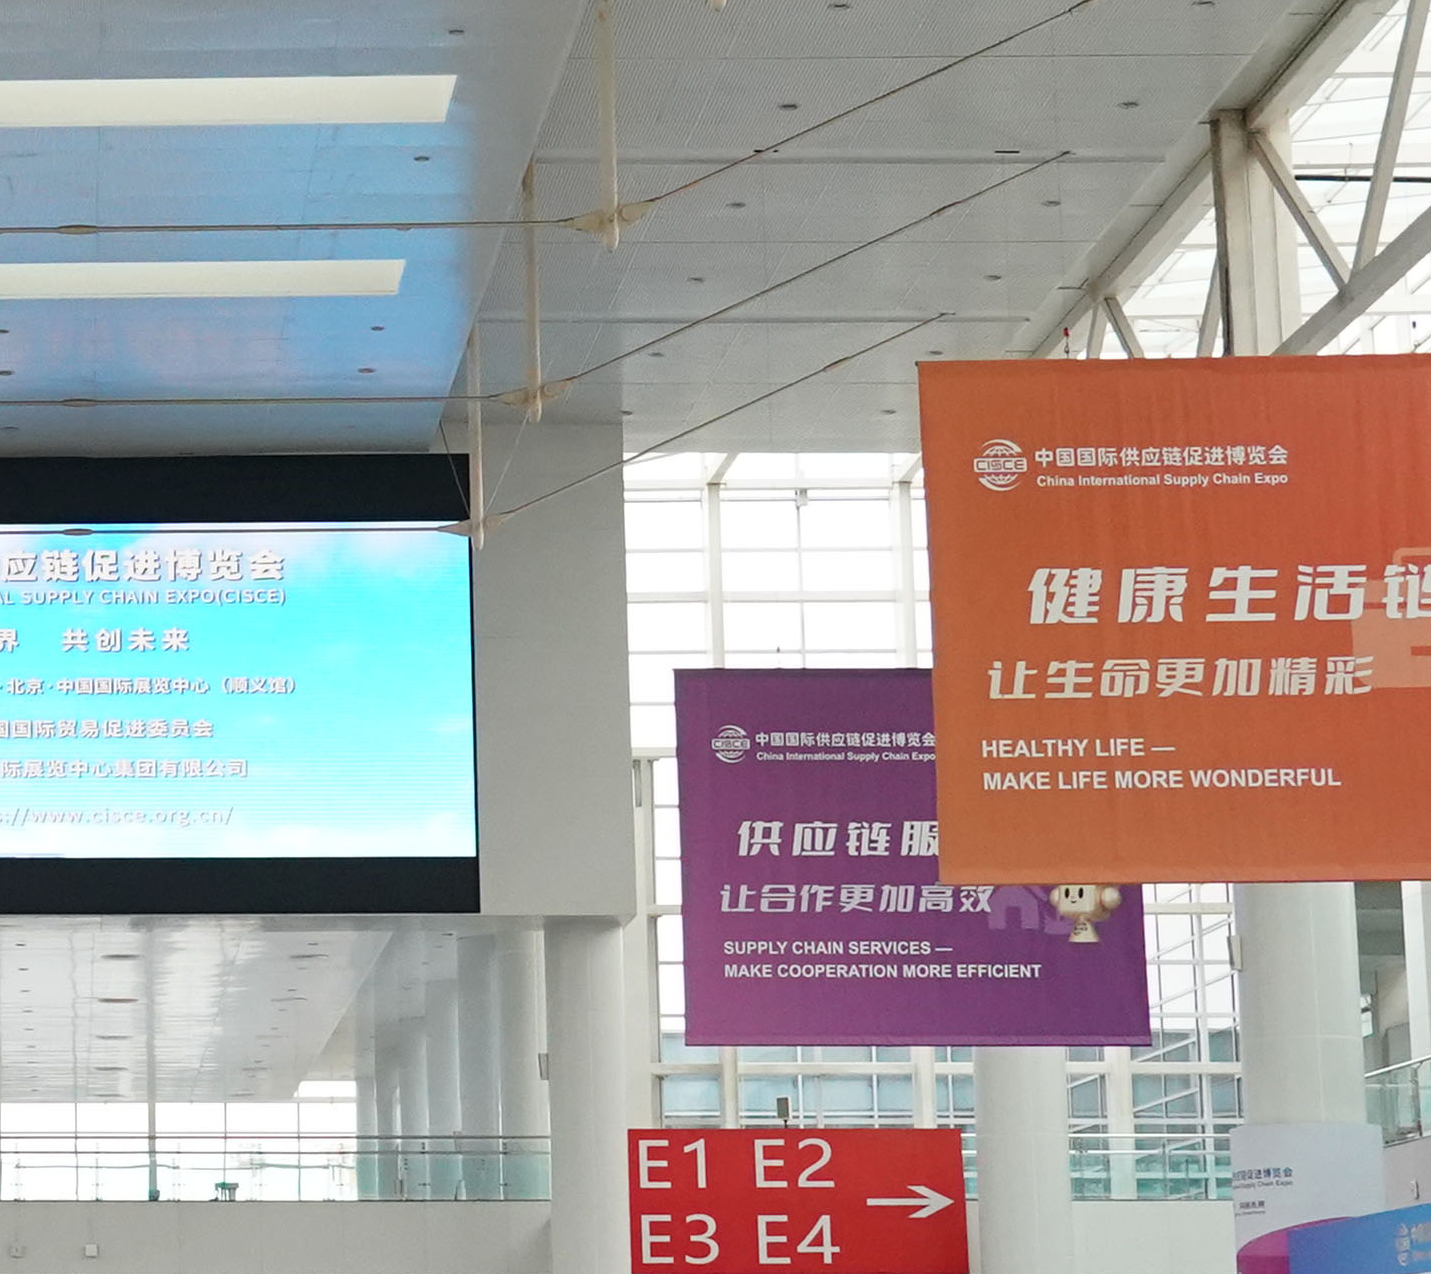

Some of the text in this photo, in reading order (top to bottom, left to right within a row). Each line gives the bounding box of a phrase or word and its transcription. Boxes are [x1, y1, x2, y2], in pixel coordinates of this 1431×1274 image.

[1035, 445, 1288, 467] 中国国际供应链促进博览会
[1037, 473, 1288, 487] China International Supply Chain Expo
[22, 589, 94, 605] SUPPLY
[99, 589, 159, 605] CHAIN
[165, 588, 287, 606] EXPO(CISCE)
[62, 627, 190, 653] 共创未来
[988, 657, 1374, 701] 让生命更加精彩
[756, 732, 936, 747] 中国国际供应链促进博览会
[982, 738, 1144, 757] HEALTHY LIFE
[756, 751, 936, 763] China International Supply Chain Expo
[984, 768, 1341, 790] MAKE LIFE MORE WONDERFUL
[720, 883, 992, 913] 让合作更加高效
[724, 941, 931, 954] SUPPLY CHAIN SERVICES
[725, 964, 1041, 978] MAKE COOPERATION MORE EFFICIENT
[639, 1138, 834, 1188] E1 E2
[641, 1214, 840, 1264] E3 E4
